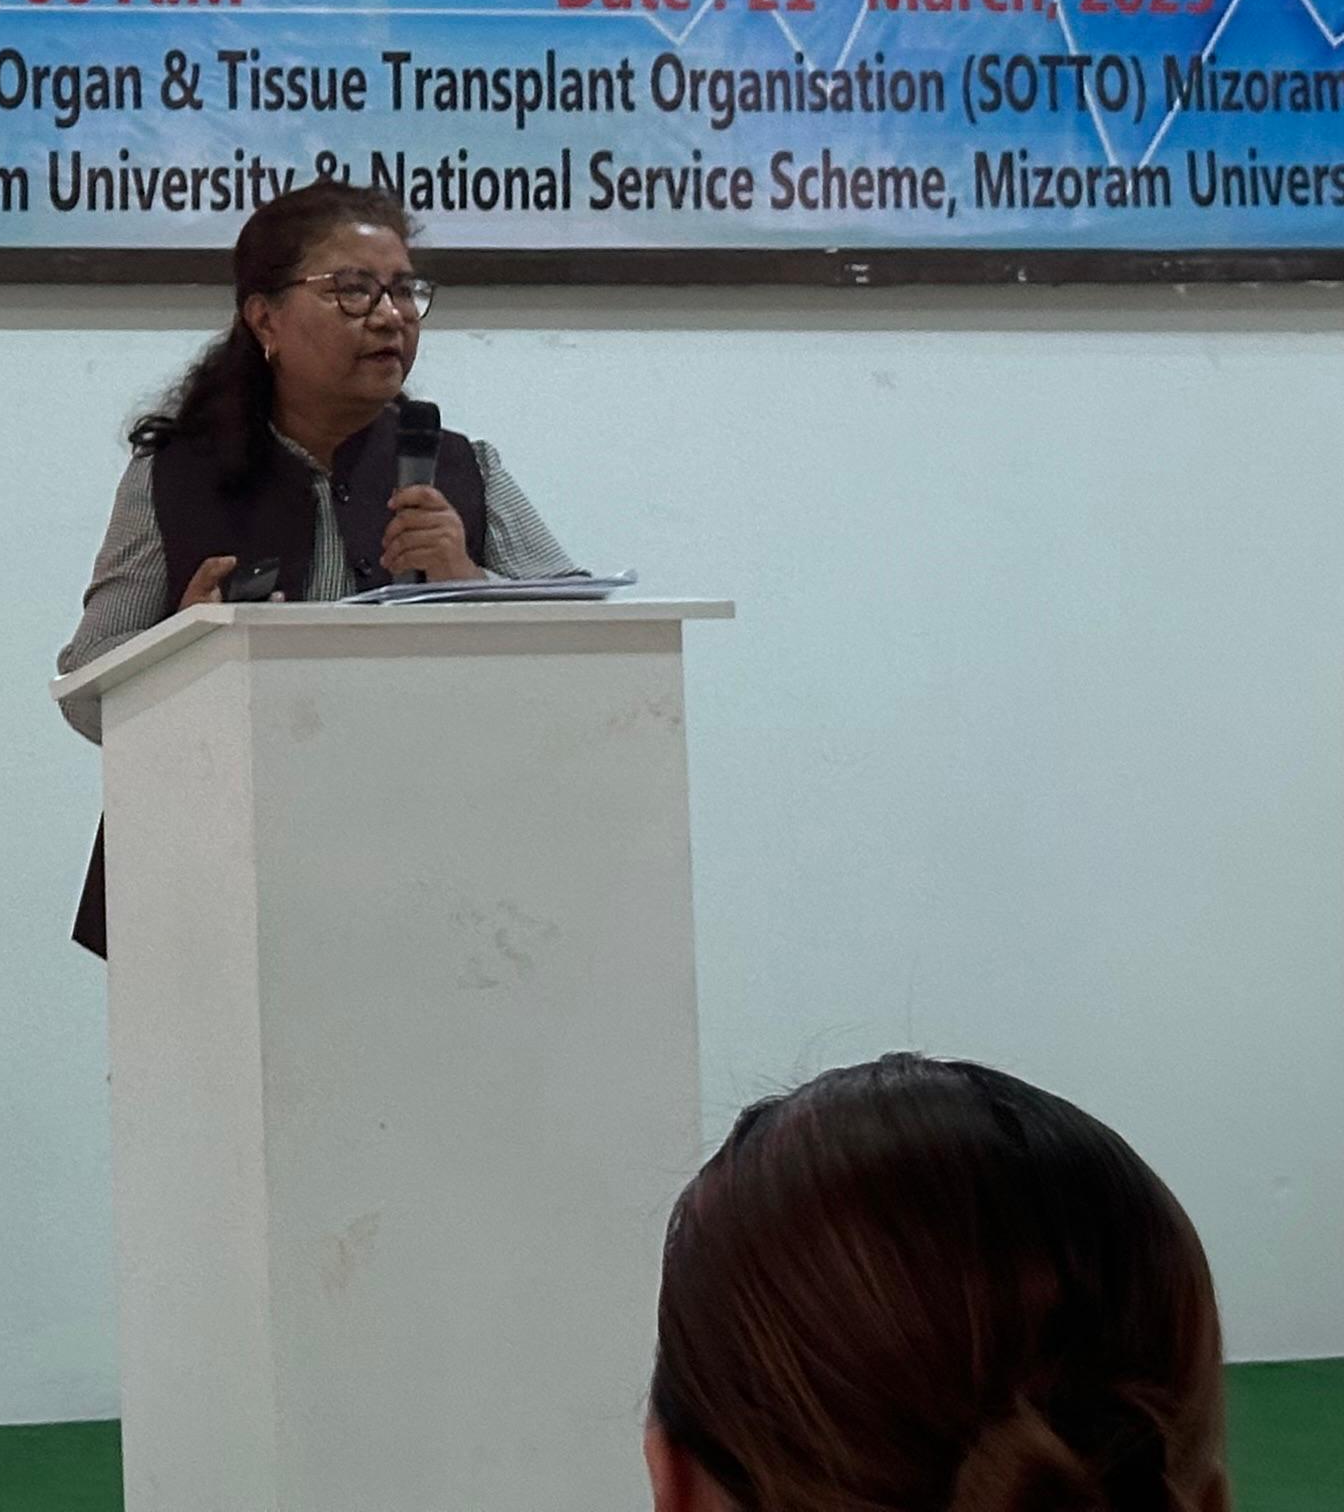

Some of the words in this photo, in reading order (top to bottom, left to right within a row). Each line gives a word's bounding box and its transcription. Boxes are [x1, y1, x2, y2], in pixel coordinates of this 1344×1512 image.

[160, 49, 204, 112] &
[217, 48, 368, 112] Tissue
[382, 50, 638, 130] Transplant
[650, 52, 945, 130] Organisation
[962, 54, 1147, 124] (SOTTO)
[1164, 52, 1344, 113] Mizoram
[371, 148, 573, 212] National
[588, 149, 754, 214] Service
[769, 147, 959, 220] Scheme,
[974, 148, 1172, 212] Mizoram
[1186, 147, 1344, 208] Univers
